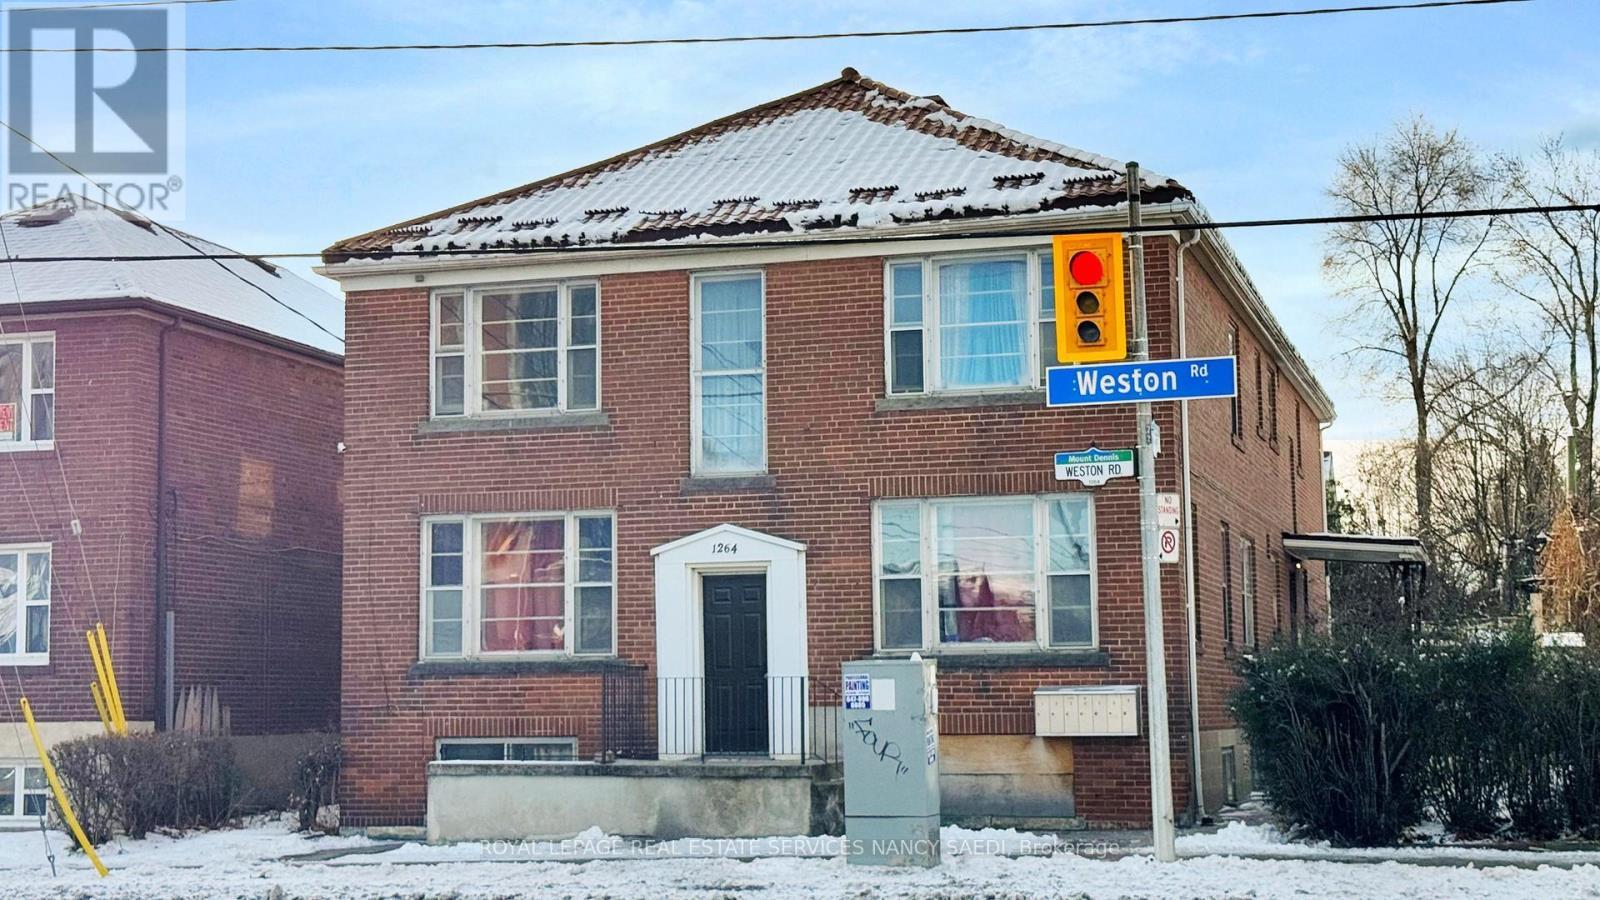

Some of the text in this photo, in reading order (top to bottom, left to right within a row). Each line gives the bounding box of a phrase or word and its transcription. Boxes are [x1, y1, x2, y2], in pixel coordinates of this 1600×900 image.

[1076, 364, 1209, 396] Weston Rd
[1068, 453, 1120, 463] Mount Dennis
[1065, 463, 1121, 477] WESTON RD
[1164, 496, 1173, 504] NO
[711, 542, 737, 554] 1264
[845, 680, 870, 691] PAINTING
